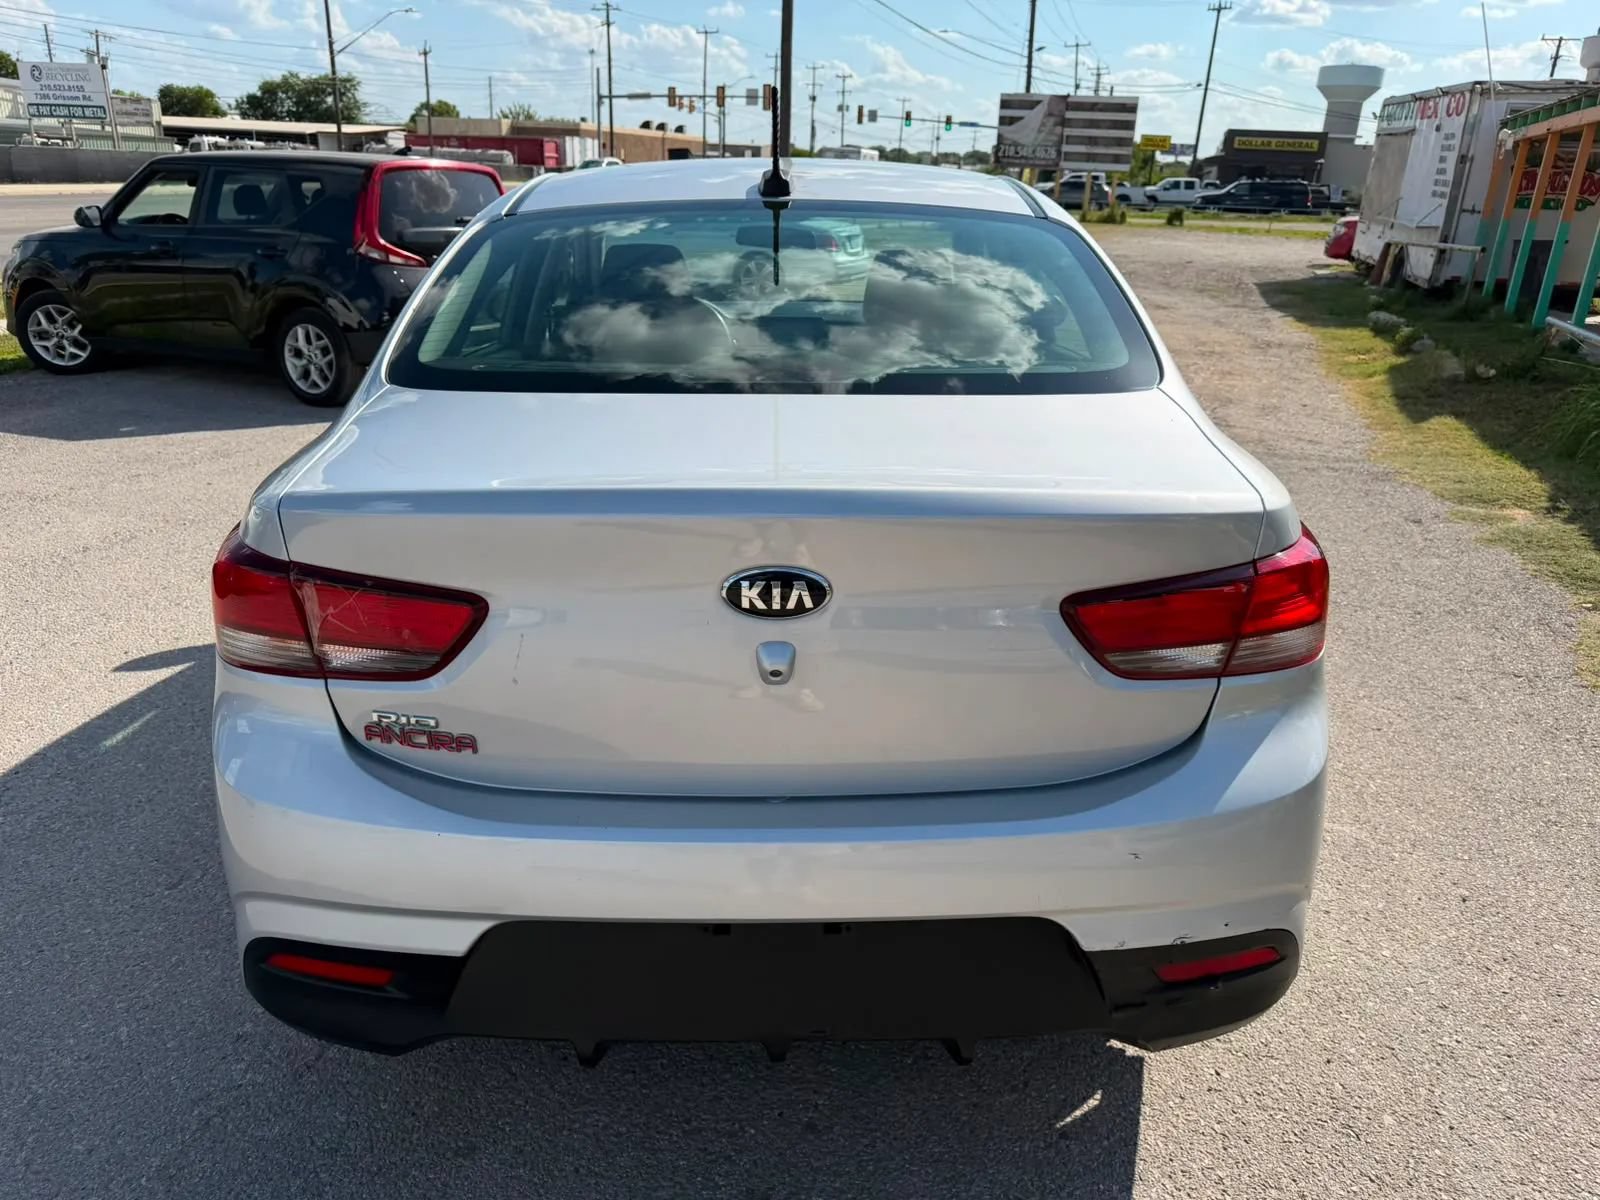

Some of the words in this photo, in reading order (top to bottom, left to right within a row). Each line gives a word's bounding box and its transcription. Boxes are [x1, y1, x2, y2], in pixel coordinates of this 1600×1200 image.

[45, 72, 91, 82] RECYCLING
[52, 93, 80, 101] Grissom
[29, 105, 39, 115] WE
[39, 105, 51, 116] PAY
[51, 106, 69, 116] CASH
[70, 106, 83, 117] FOR
[84, 107, 106, 118] METAL
[1237, 139, 1273, 148] DOLLAR
[1274, 140, 1317, 150] GENERAL
[740, 580, 814, 610] KIA
[364, 723, 479, 755] ANCIRA
